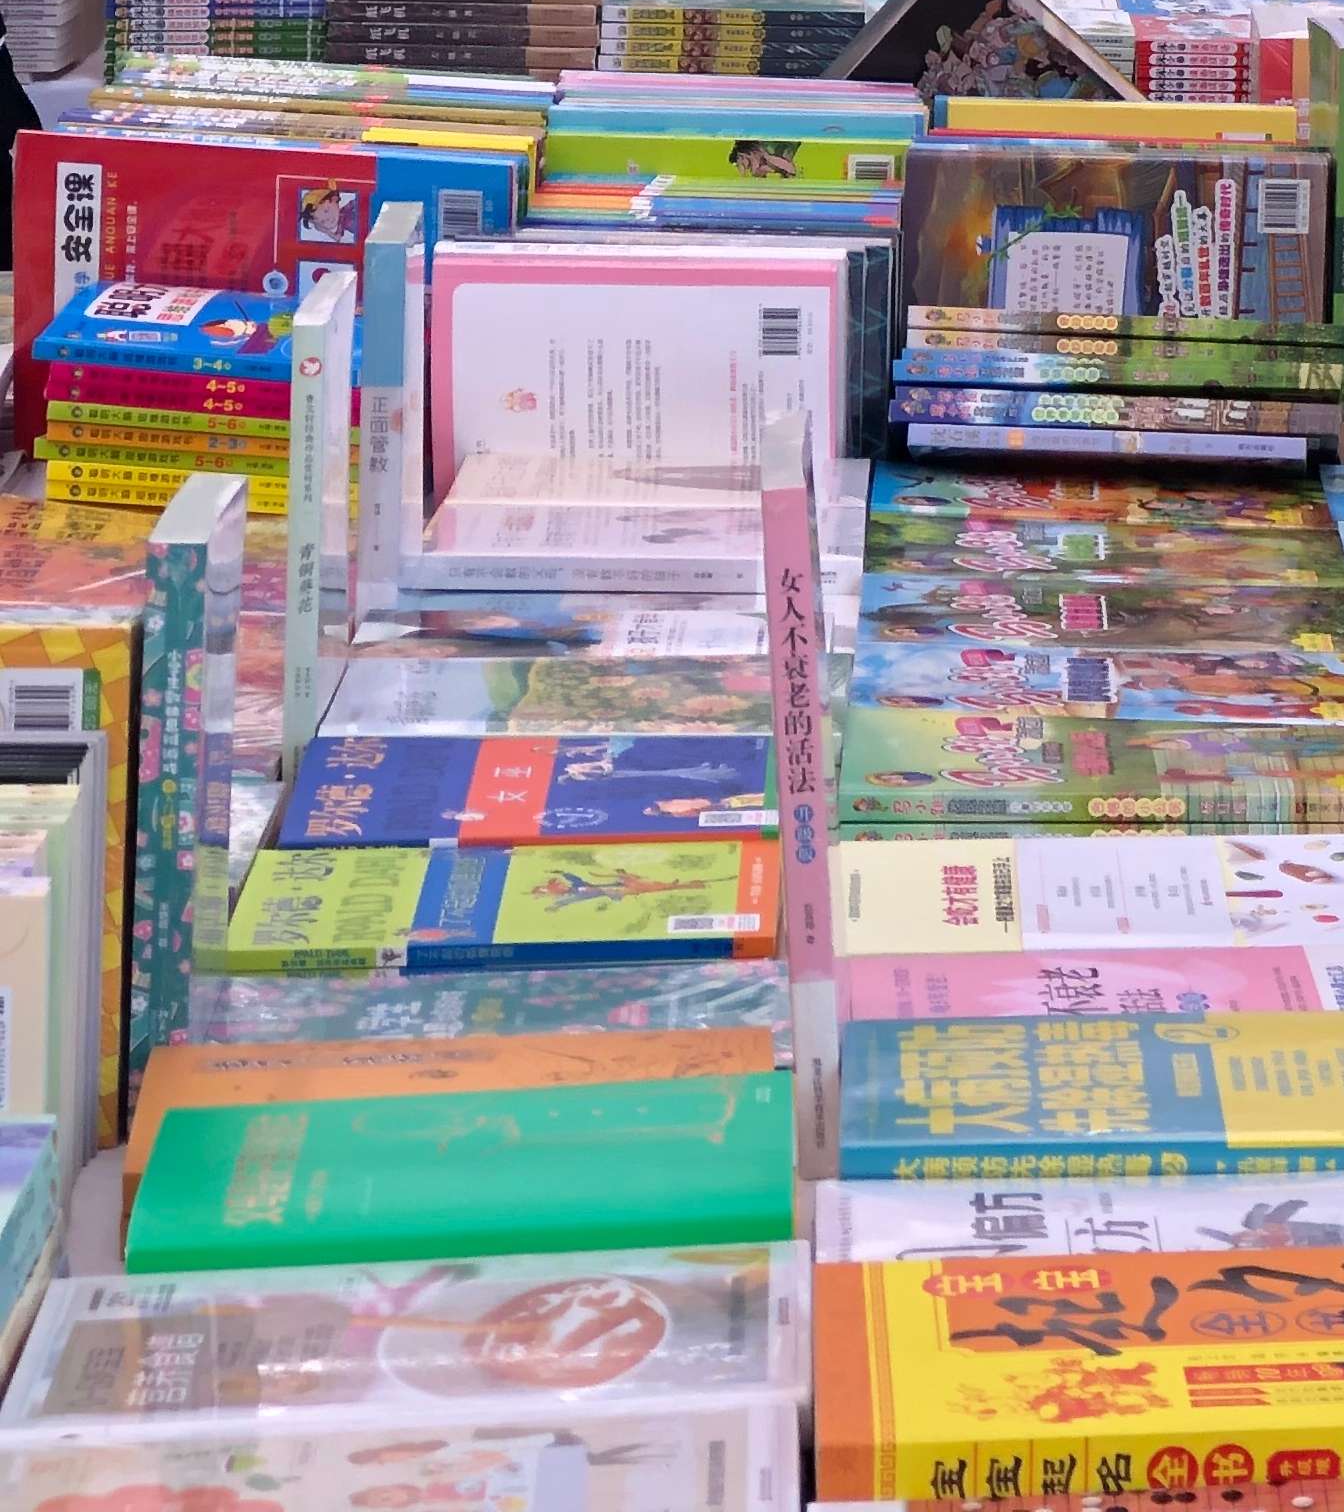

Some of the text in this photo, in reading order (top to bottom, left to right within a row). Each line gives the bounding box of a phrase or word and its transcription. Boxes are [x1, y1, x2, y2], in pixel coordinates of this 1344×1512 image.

[62, 172, 95, 263] 安全课
[107, 171, 119, 188] KE
[368, 395, 389, 474] 正面管教
[780, 567, 817, 795] 女人不衰老的活法
[492, 765, 532, 804] 女巫
[895, 1023, 1032, 1136] 大病预防
[1033, 1020, 1153, 1136] 先除湿热毒
[934, 1266, 1101, 1297] 宝宝
[930, 1449, 1135, 1500] 宝宝起名
[1155, 1447, 1251, 1483] 全书
